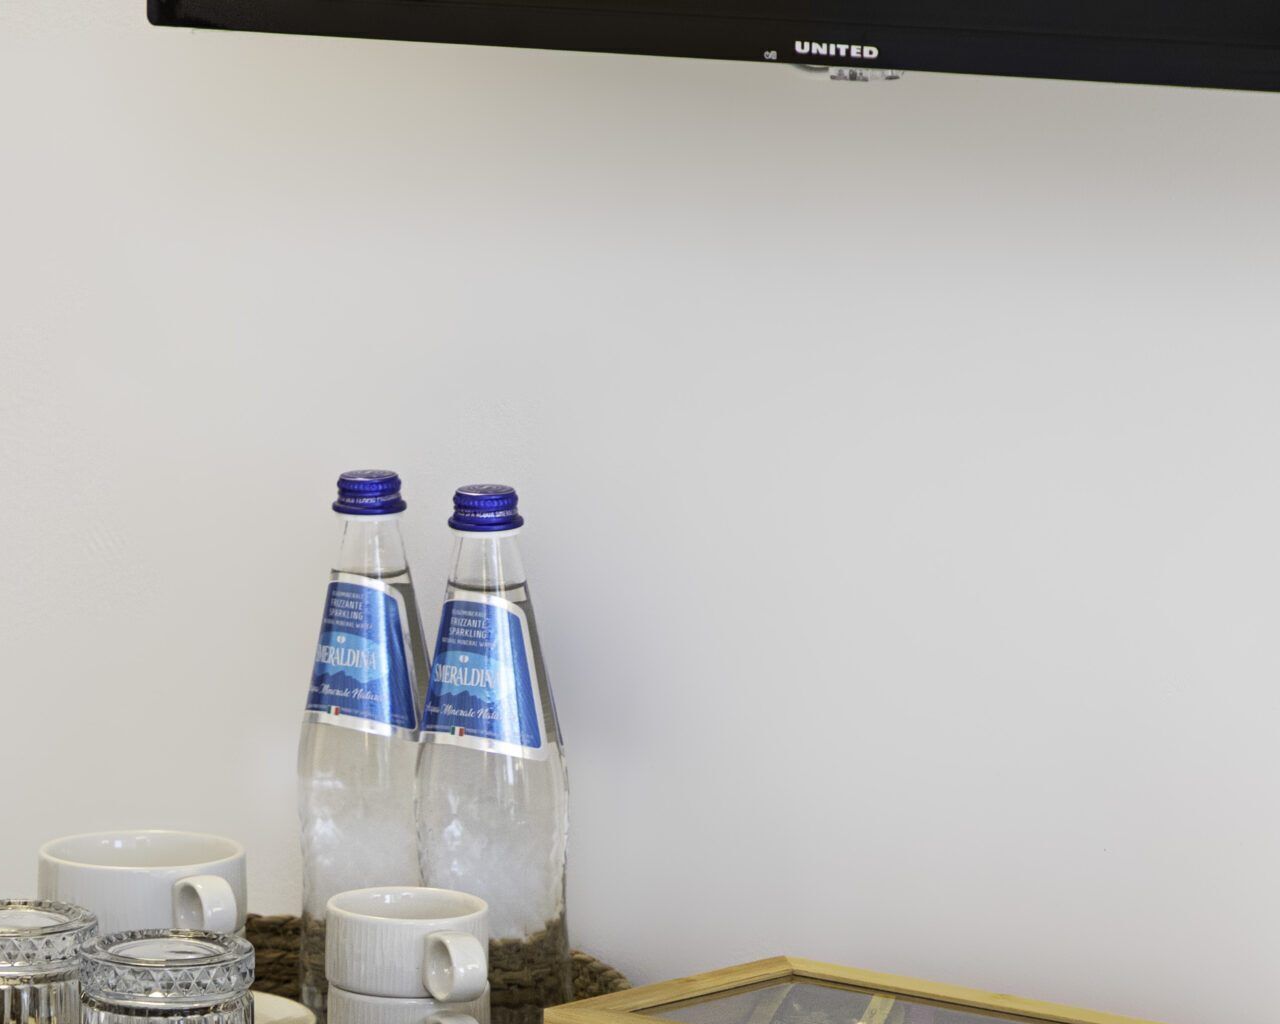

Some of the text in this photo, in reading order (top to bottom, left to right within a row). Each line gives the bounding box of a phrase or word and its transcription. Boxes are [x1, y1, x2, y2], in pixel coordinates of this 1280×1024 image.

[794, 40, 879, 59] UNITED
[329, 607, 363, 620] SPARKLING
[450, 616, 487, 629] FRIZZANTE
[449, 626, 487, 639] SPARKLING
[434, 663, 497, 688] SMERALDIN
[441, 703, 476, 718] Minerale
